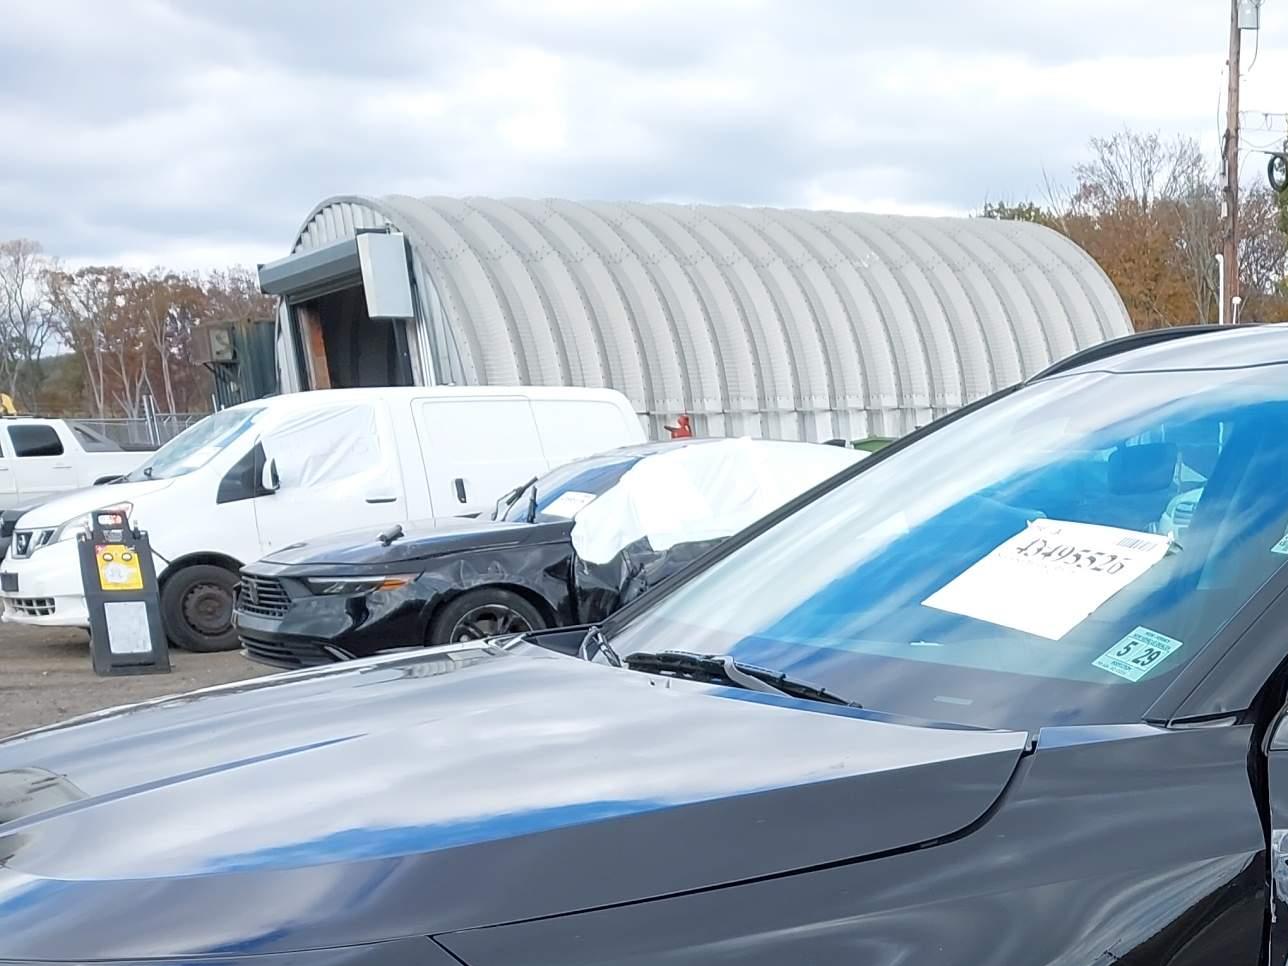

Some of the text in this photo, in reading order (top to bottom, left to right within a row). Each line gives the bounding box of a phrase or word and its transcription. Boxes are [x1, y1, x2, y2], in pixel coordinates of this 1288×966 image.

[1016, 539, 1132, 575] 43495526
[1116, 640, 1139, 657] 5
[1132, 647, 1162, 667] 29
